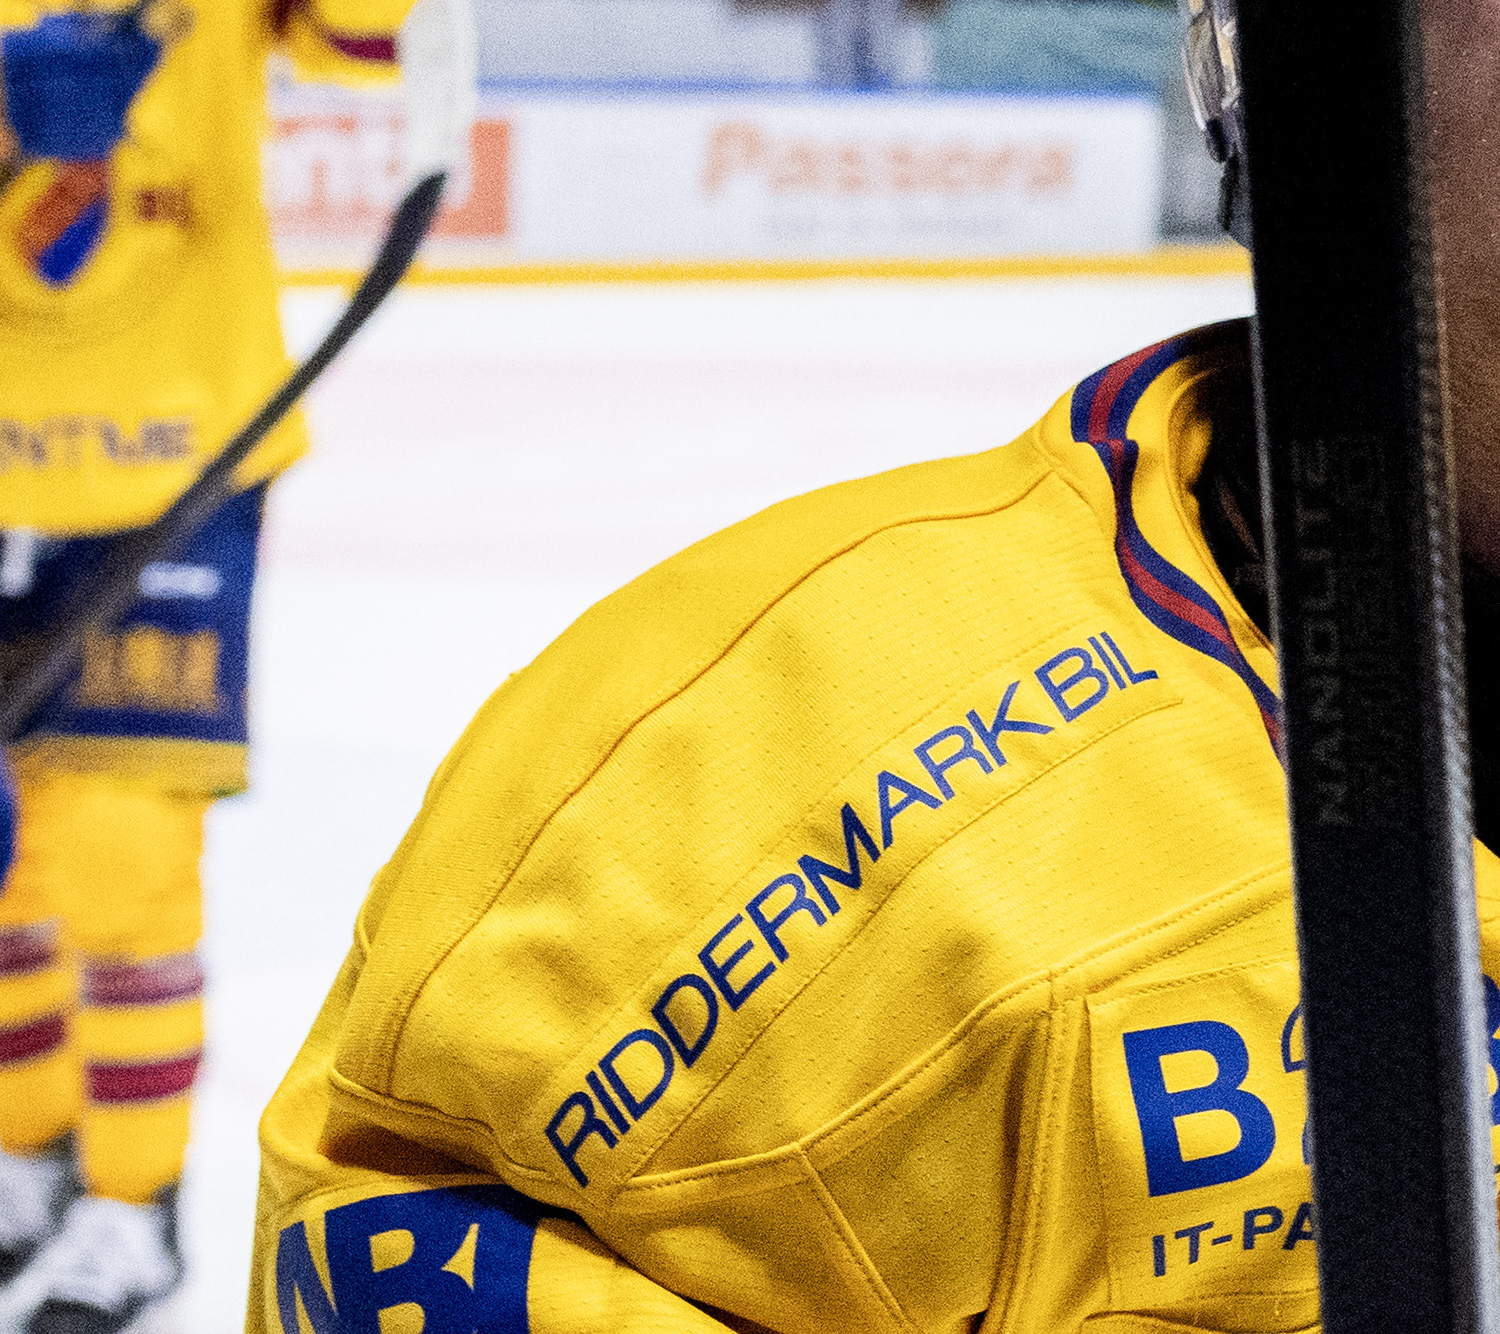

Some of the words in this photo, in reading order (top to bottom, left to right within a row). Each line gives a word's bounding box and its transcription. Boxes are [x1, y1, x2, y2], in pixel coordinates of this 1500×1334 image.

[1290, 436, 1352, 830] NANOLITE
[544, 680, 1055, 1187] RIDDERMARK
[1034, 629, 1159, 728] BIL
